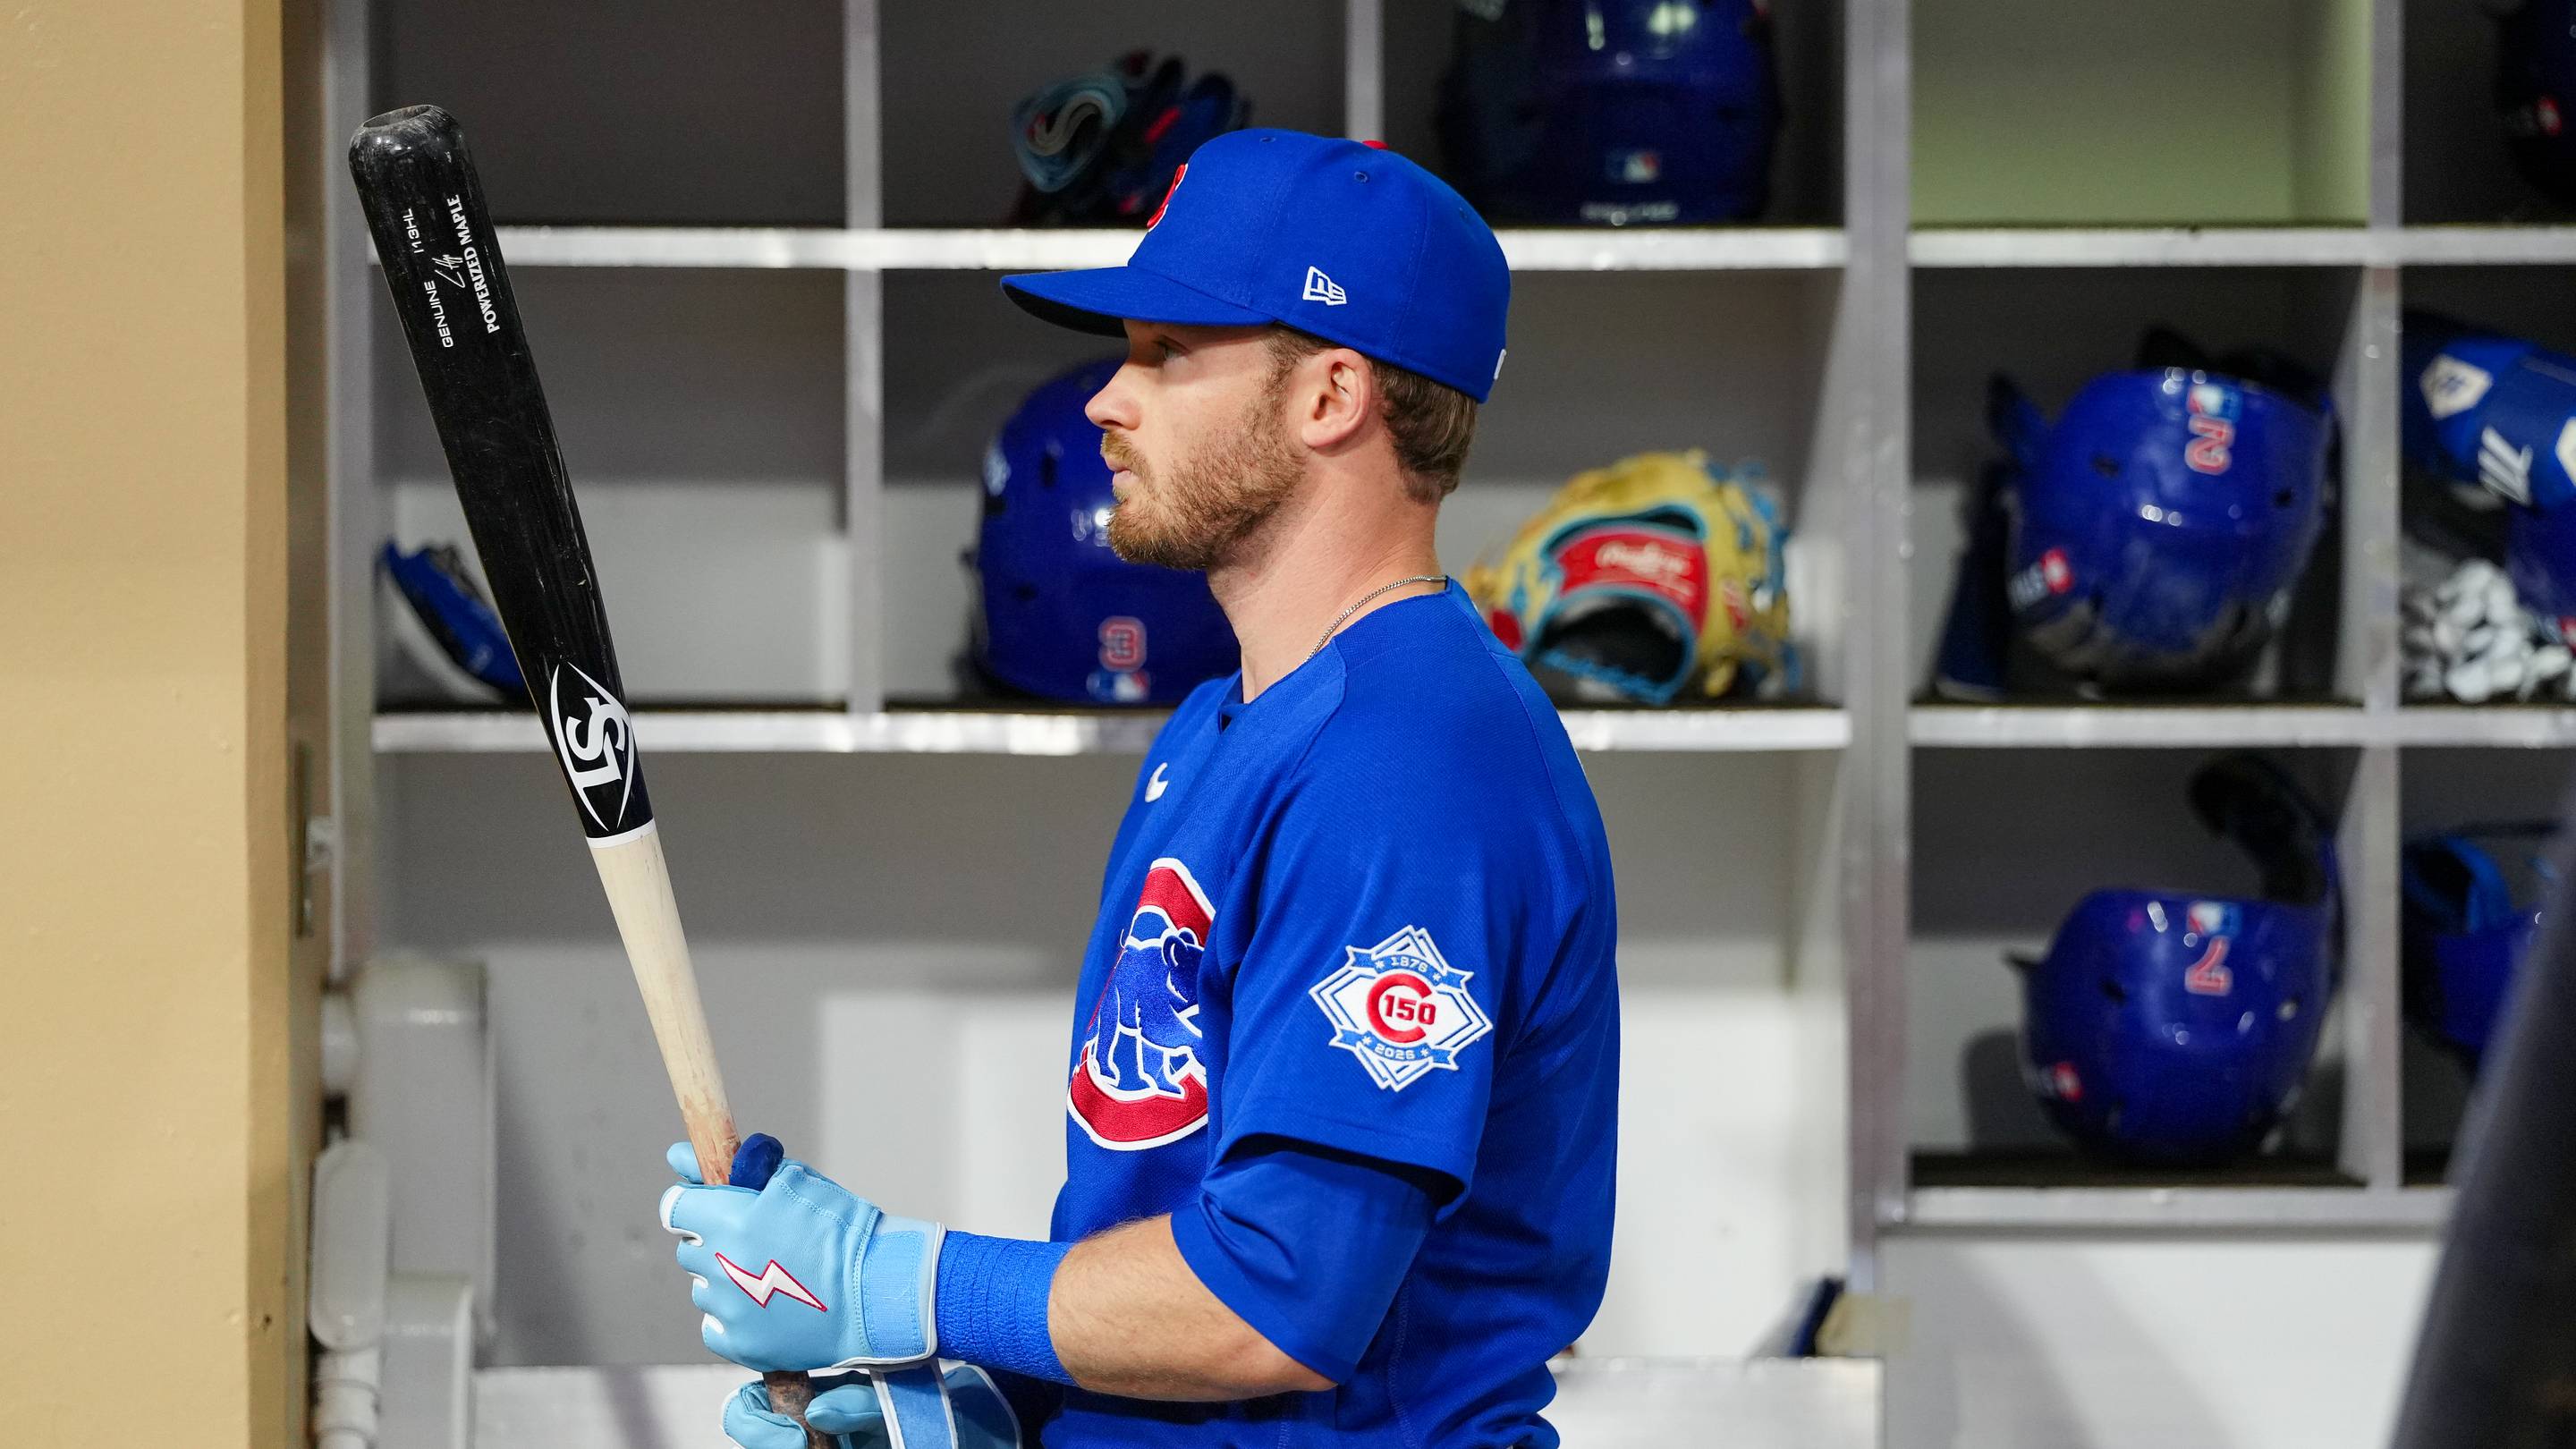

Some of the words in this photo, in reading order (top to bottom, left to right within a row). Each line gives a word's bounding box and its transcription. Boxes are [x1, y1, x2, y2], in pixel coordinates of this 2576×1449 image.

[447, 194, 472, 245] MAPLE
[424, 280, 453, 347] GENUINE
[463, 246, 500, 334] POWERIZED
[2185, 414, 2236, 476] 2
[1097, 615, 1147, 672] 3
[2185, 936, 2233, 996] 7
[1366, 973, 1433, 1044] C
[1384, 995, 1436, 1026] 150
[1374, 1044, 1416, 1060] 2026
